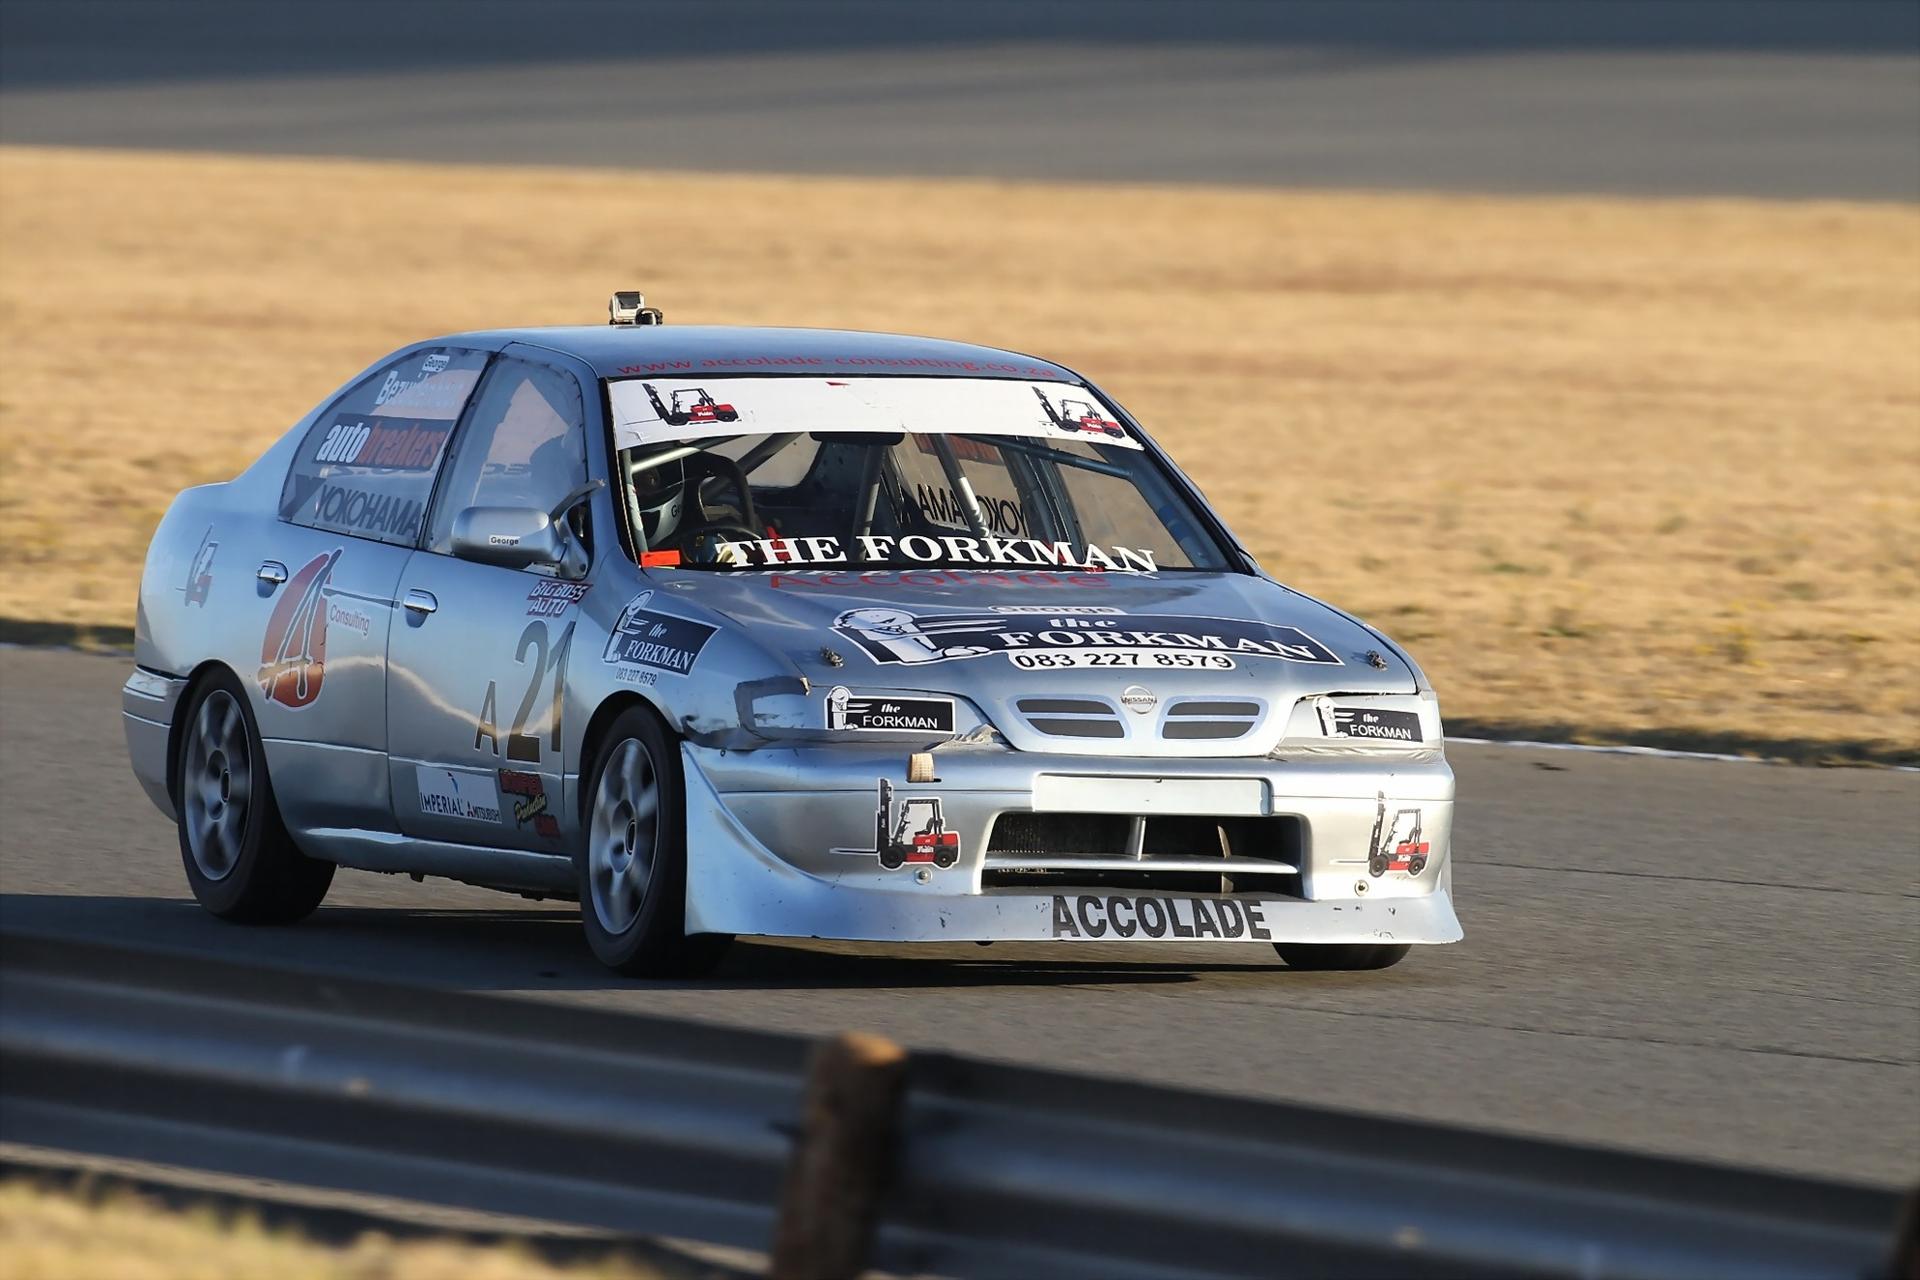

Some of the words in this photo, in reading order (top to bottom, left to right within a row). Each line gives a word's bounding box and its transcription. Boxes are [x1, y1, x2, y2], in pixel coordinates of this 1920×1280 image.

[314, 484, 423, 538] YOKOHAMA
[490, 536, 519, 545] George
[715, 536, 848, 568] THE
[856, 535, 1160, 573] FORKMAN
[530, 581, 560, 597] BIG
[552, 583, 589, 601] BOSS
[529, 597, 569, 614] AUTO
[330, 603, 370, 637] Consulting
[1048, 618, 1118, 629] the
[648, 623, 668, 638] the
[992, 630, 1318, 660] FORKMAN
[624, 639, 695, 670] FORKMAN
[1015, 653, 1076, 669] 083
[1084, 652, 1141, 667] 227
[1156, 653, 1234, 669] 8579
[474, 679, 500, 756] A
[505, 619, 578, 764] 21
[880, 703, 901, 714] the
[862, 715, 938, 730] FORKMAN
[1362, 713, 1380, 723] the
[1349, 724, 1412, 740] FORKMAN
[420, 791, 465, 816] IMPERIAL
[1052, 894, 1273, 940] ACCOLADE
